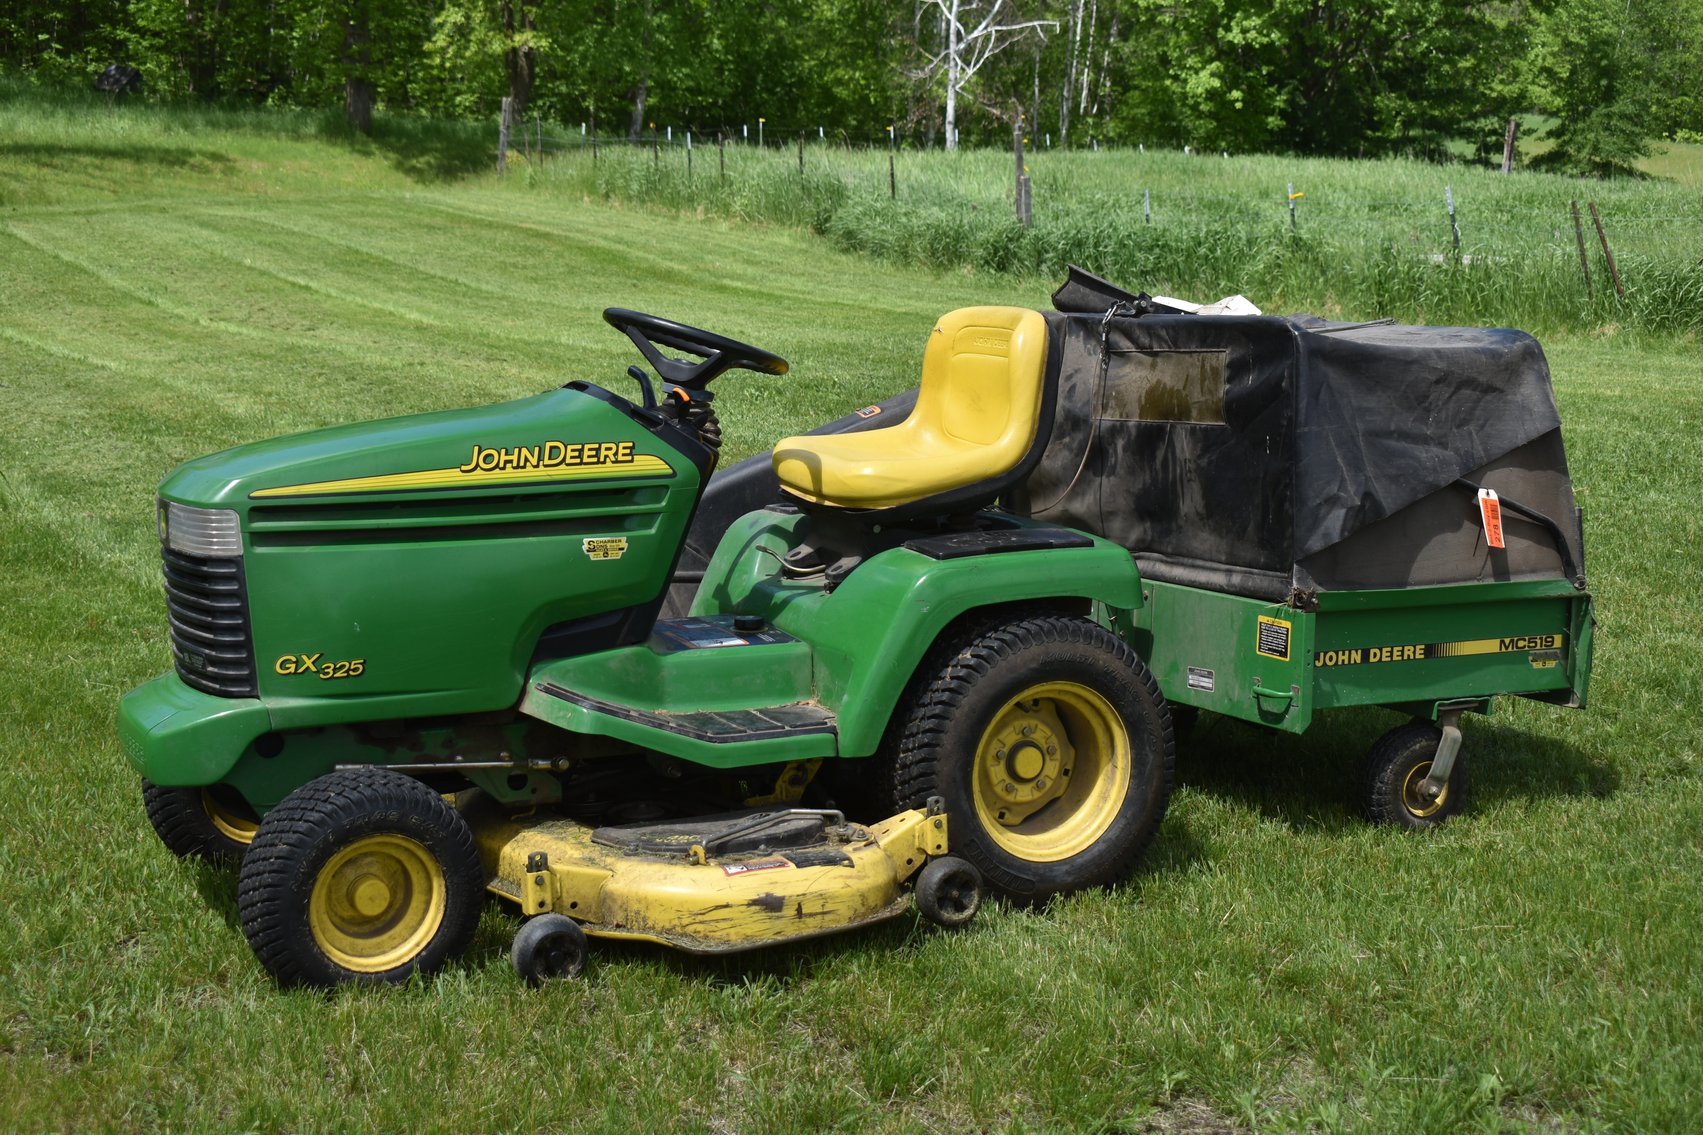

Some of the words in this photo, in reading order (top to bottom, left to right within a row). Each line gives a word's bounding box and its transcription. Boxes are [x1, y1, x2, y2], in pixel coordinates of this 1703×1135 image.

[460, 444, 540, 473] JOHN
[543, 440, 635, 468] DEERE
[1499, 635, 1555, 652] MC519
[1315, 649, 1362, 667] JOHN
[1369, 644, 1425, 663] DEERE
